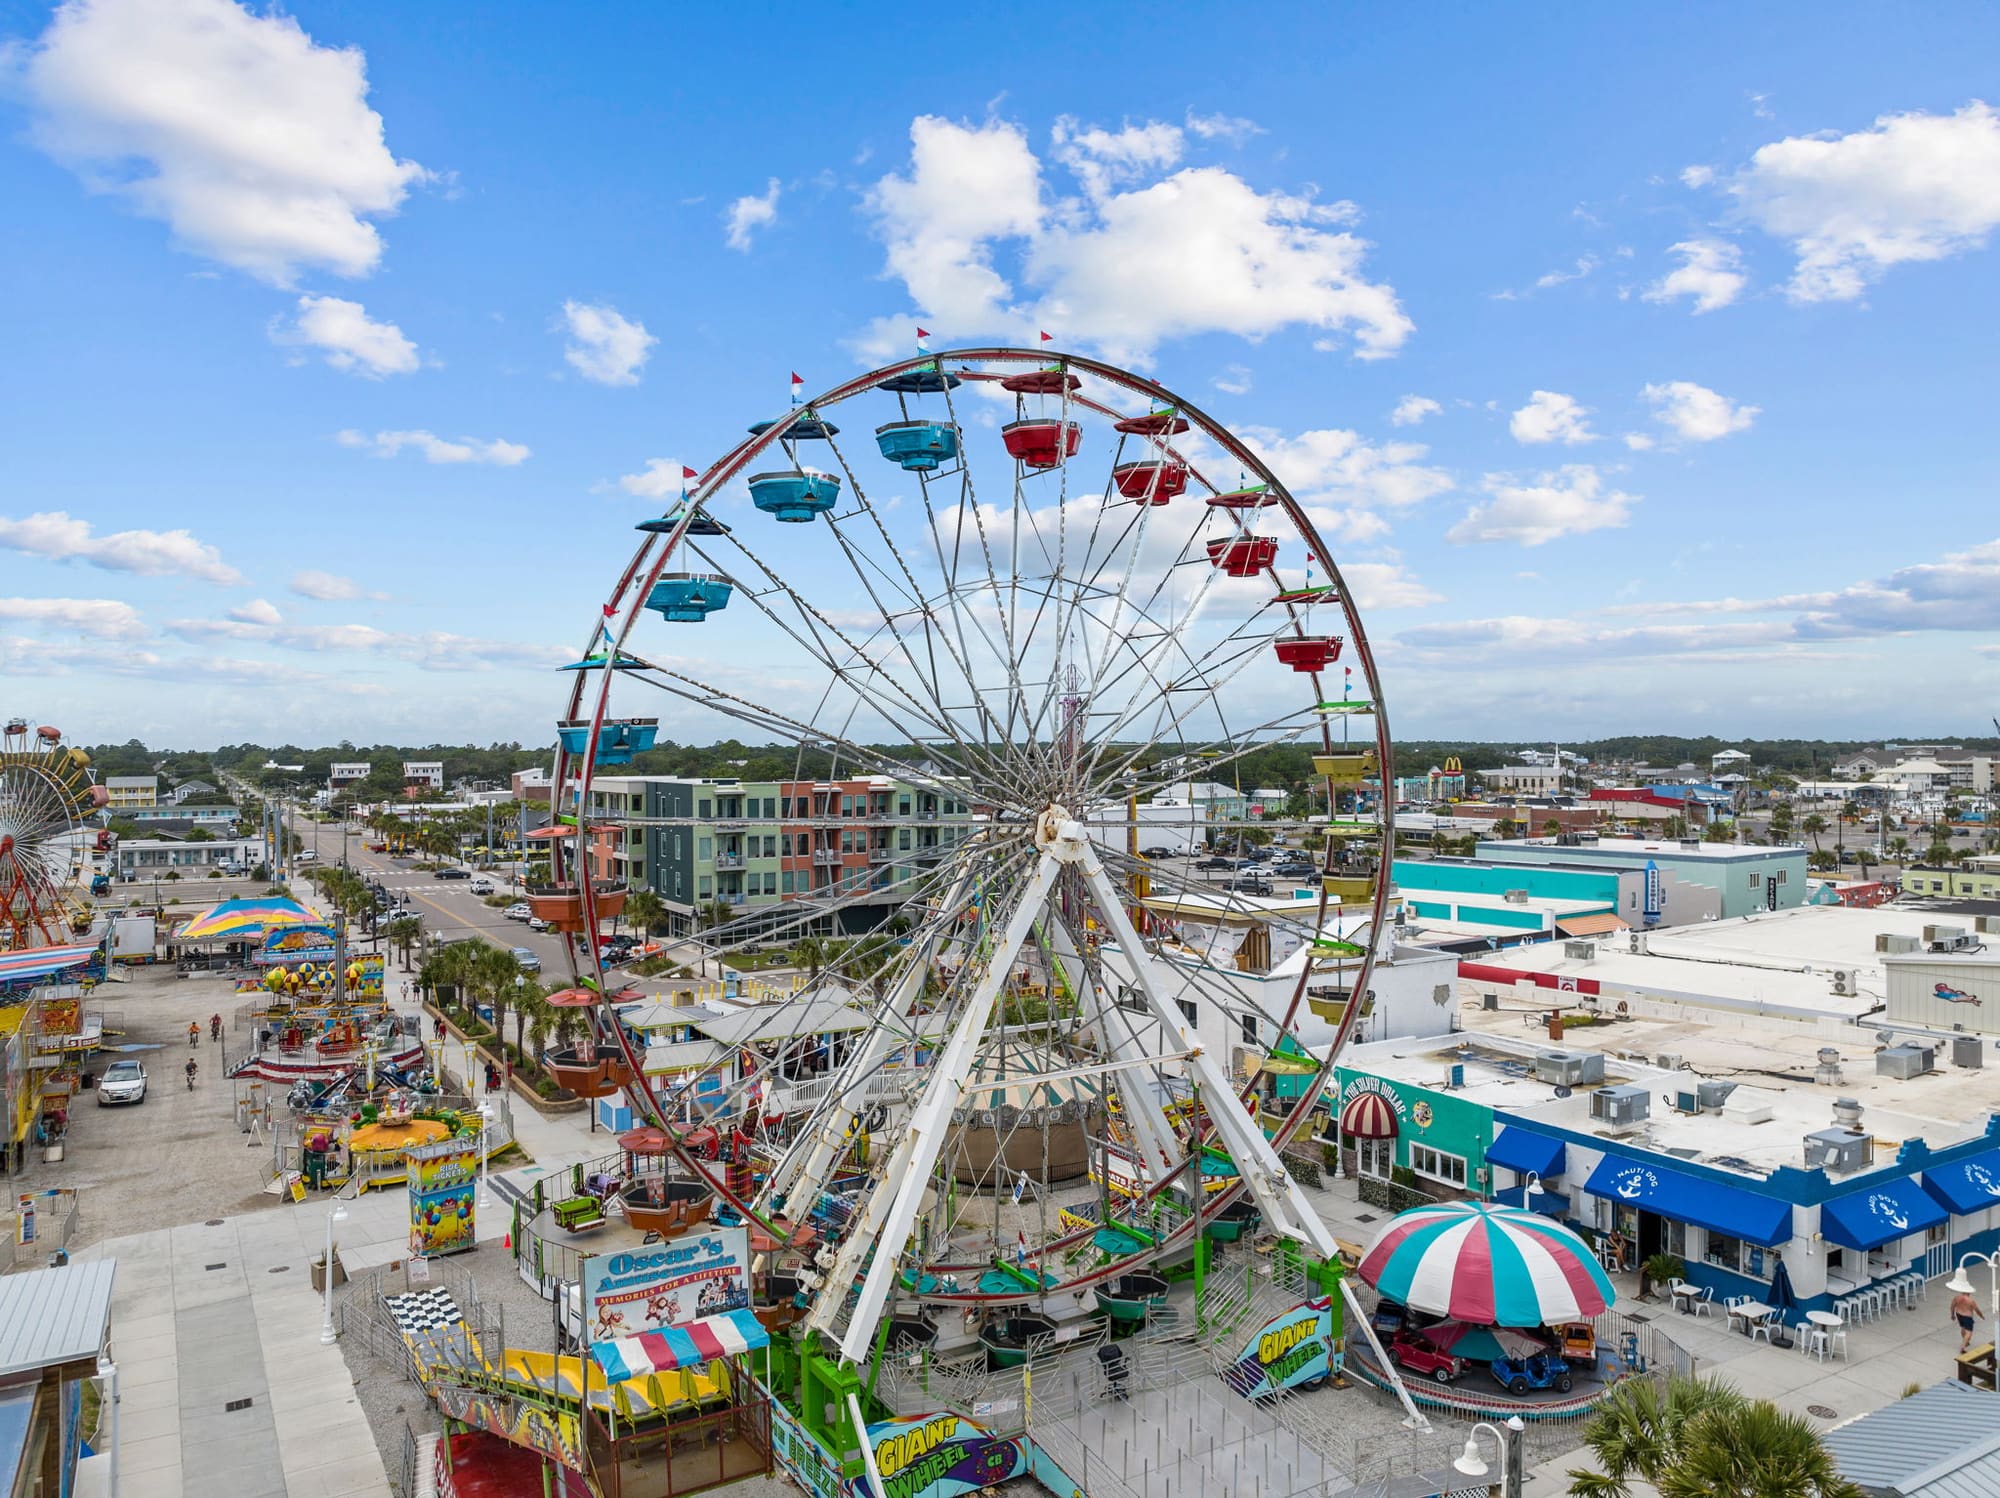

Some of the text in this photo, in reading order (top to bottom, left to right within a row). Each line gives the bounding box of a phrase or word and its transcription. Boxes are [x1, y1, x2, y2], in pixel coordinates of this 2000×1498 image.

[1344, 1076, 1407, 1115] THE SILVER DOLLAR
[432, 1168, 467, 1181] TICKETS
[439, 1163, 460, 1173] RIDE
[1617, 1167, 1659, 1188] NAUTI DOG
[1868, 1195, 1879, 1215] NAUTI
[595, 1254, 737, 1293] Amusements
[608, 1237, 724, 1276] Oscar's
[600, 1289, 655, 1305] MEMORIES
[659, 1281, 679, 1294] FOR
[693, 1267, 737, 1281] LIFETIME
[1258, 1316, 1320, 1366] GIANT
[1265, 1341, 1325, 1389] WHEEL
[876, 1415, 960, 1478] GIANT
[986, 1453, 1003, 1468] CB
[881, 1443, 972, 1498] WHEEL
